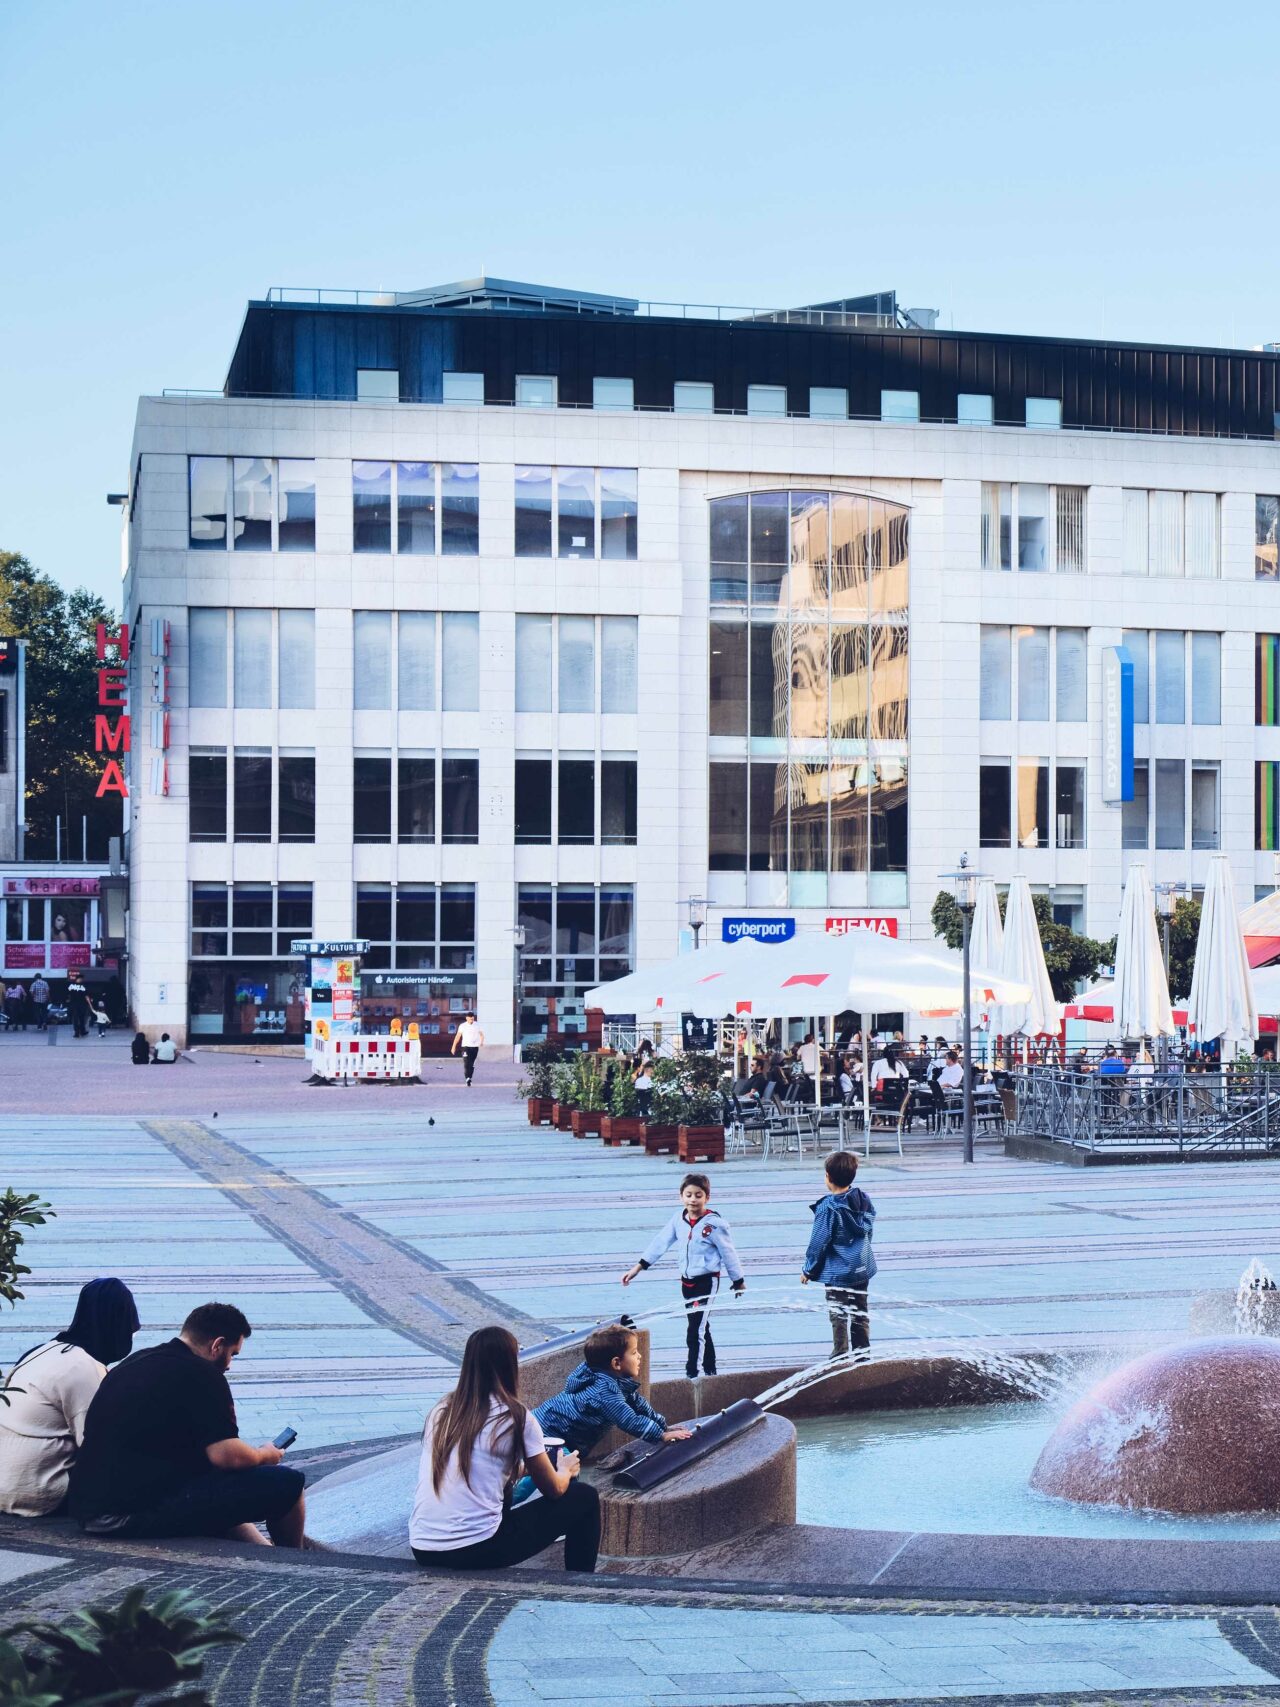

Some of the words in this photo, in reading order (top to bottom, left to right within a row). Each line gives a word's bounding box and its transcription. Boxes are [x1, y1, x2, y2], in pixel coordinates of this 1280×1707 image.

[95, 624, 131, 797] HEMA
[1106, 664, 1118, 788] cyberport
[728, 922, 786, 937] cyberport
